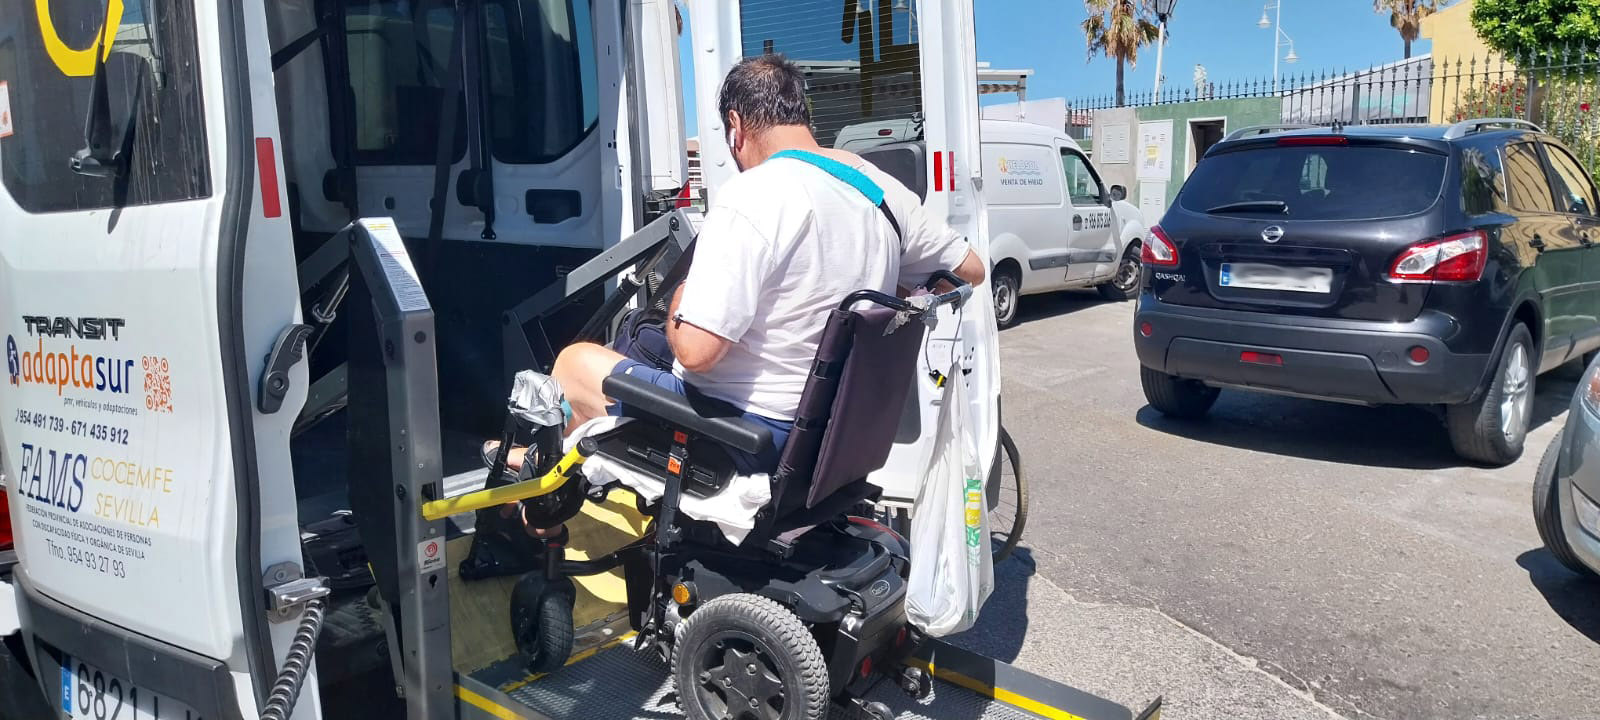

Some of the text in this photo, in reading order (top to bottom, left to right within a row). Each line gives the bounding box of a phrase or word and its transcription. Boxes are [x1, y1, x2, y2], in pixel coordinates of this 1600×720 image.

[1019, 178, 1027, 186] DE
[1155, 272, 1186, 282] QASHQAI
[22, 315, 126, 341] TRANSIT
[22, 336, 135, 396] adaptasur
[103, 401, 138, 416] adaptaciones
[19, 409, 31, 425] 954
[33, 414, 47, 429] 491
[50, 416, 64, 433] 739
[71, 420, 87, 438] 671
[90, 424, 107, 441] 435
[110, 427, 129, 446] 912
[18, 442, 88, 513] FAMS
[91, 456, 174, 493] COCEMFE
[94, 492, 160, 529] SEVILLA
[32, 519, 41, 529] CON
[118, 543, 125, 554] DE
[125, 545, 146, 560] SEVILLA
[73, 518, 79, 528] DE
[79, 520, 116, 537] ASOCIACIONES
[116, 529, 124, 539] DE
[124, 530, 152, 547] PERSONAS
[67, 546, 83, 565] 954
[85, 551, 97, 570] 93
[99, 555, 110, 573] 27
[112, 560, 126, 578] 93
[78, 662, 138, 720] 6821
